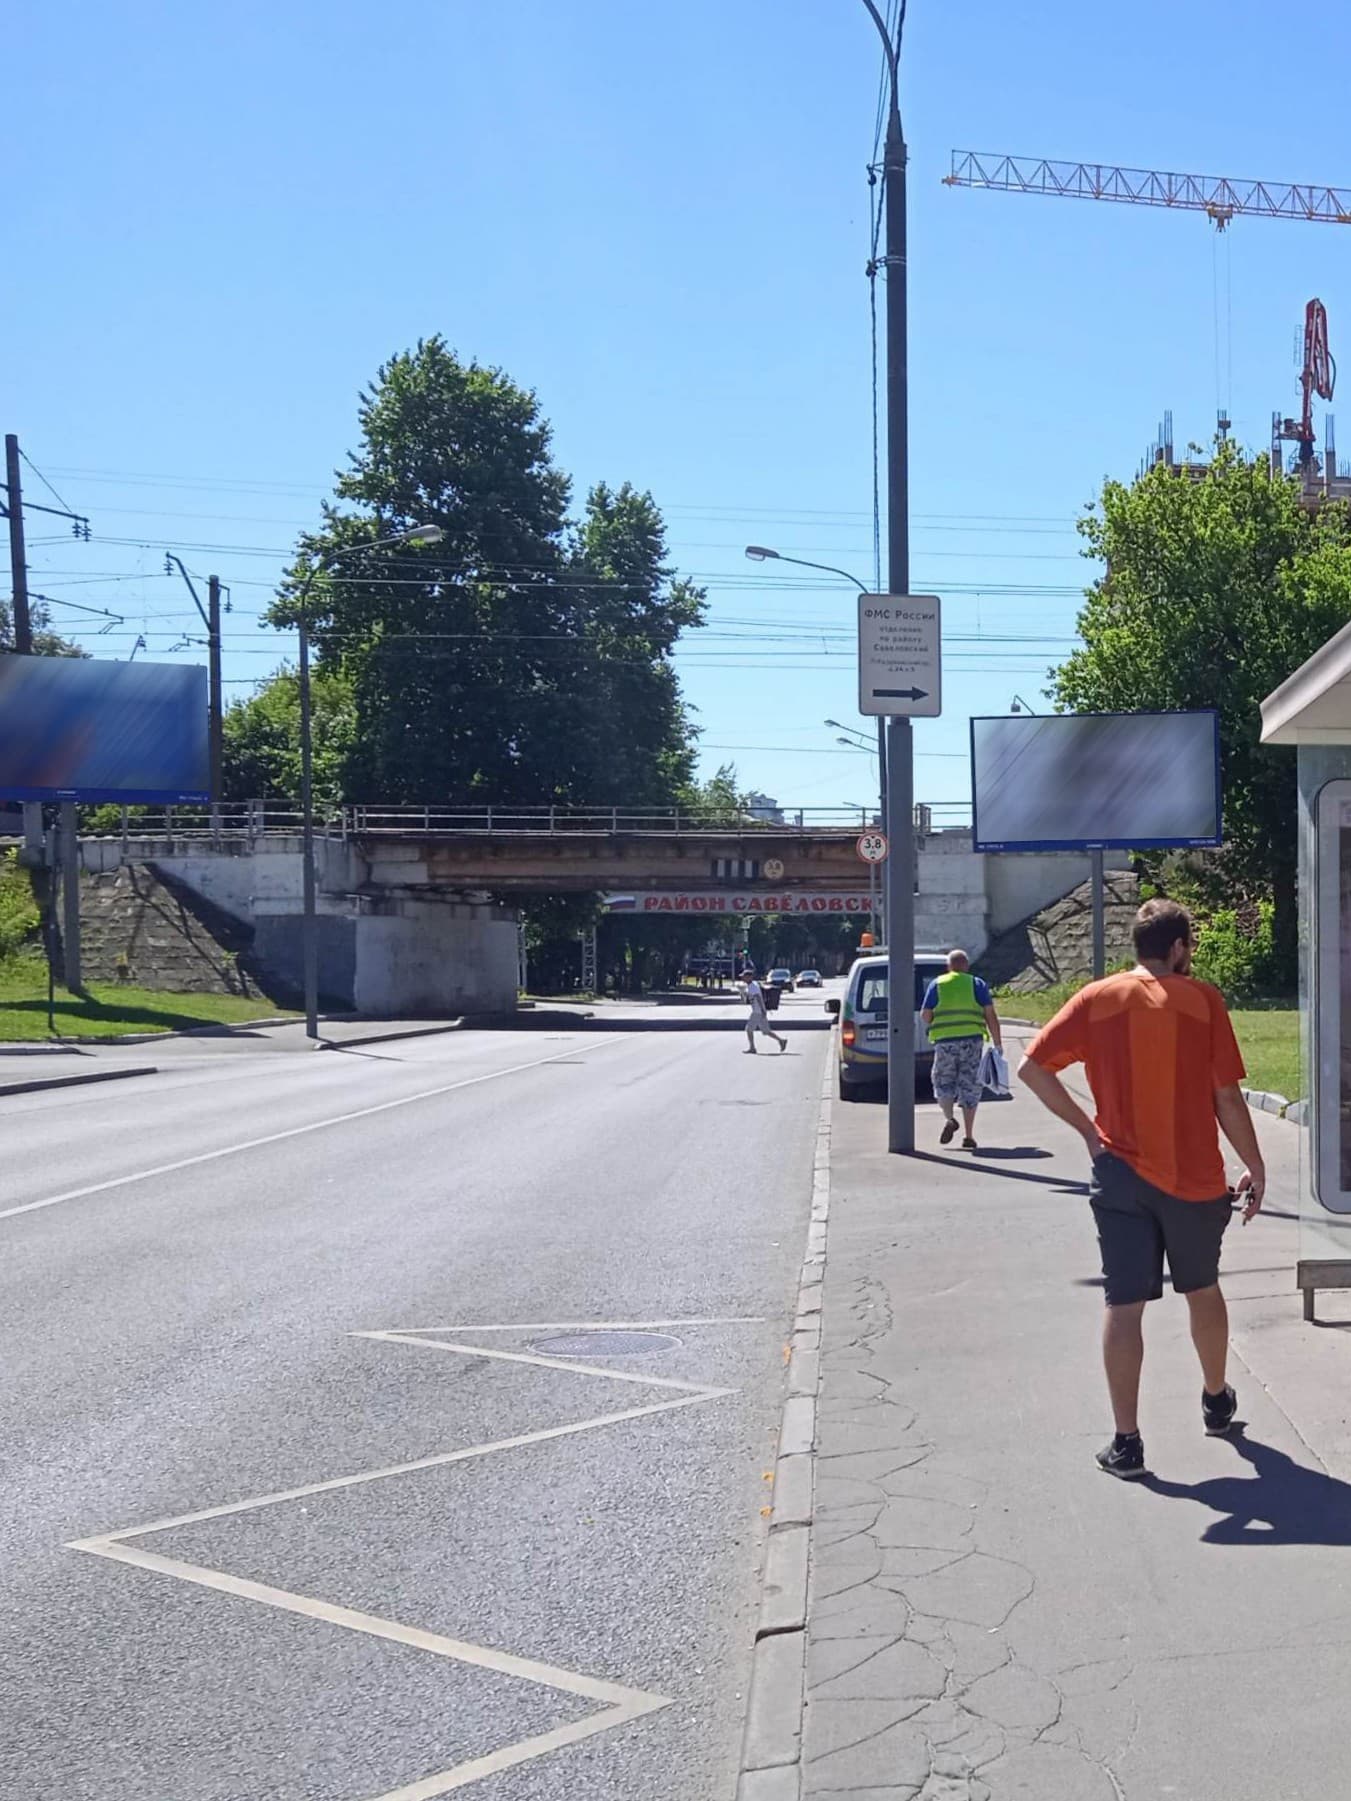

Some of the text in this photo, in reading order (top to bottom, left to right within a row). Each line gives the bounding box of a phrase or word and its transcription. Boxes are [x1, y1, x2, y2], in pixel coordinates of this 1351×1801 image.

[864, 608, 936, 620] ФМС России
[644, 890, 874, 912] РАЙОН САВЁЛОВСК
